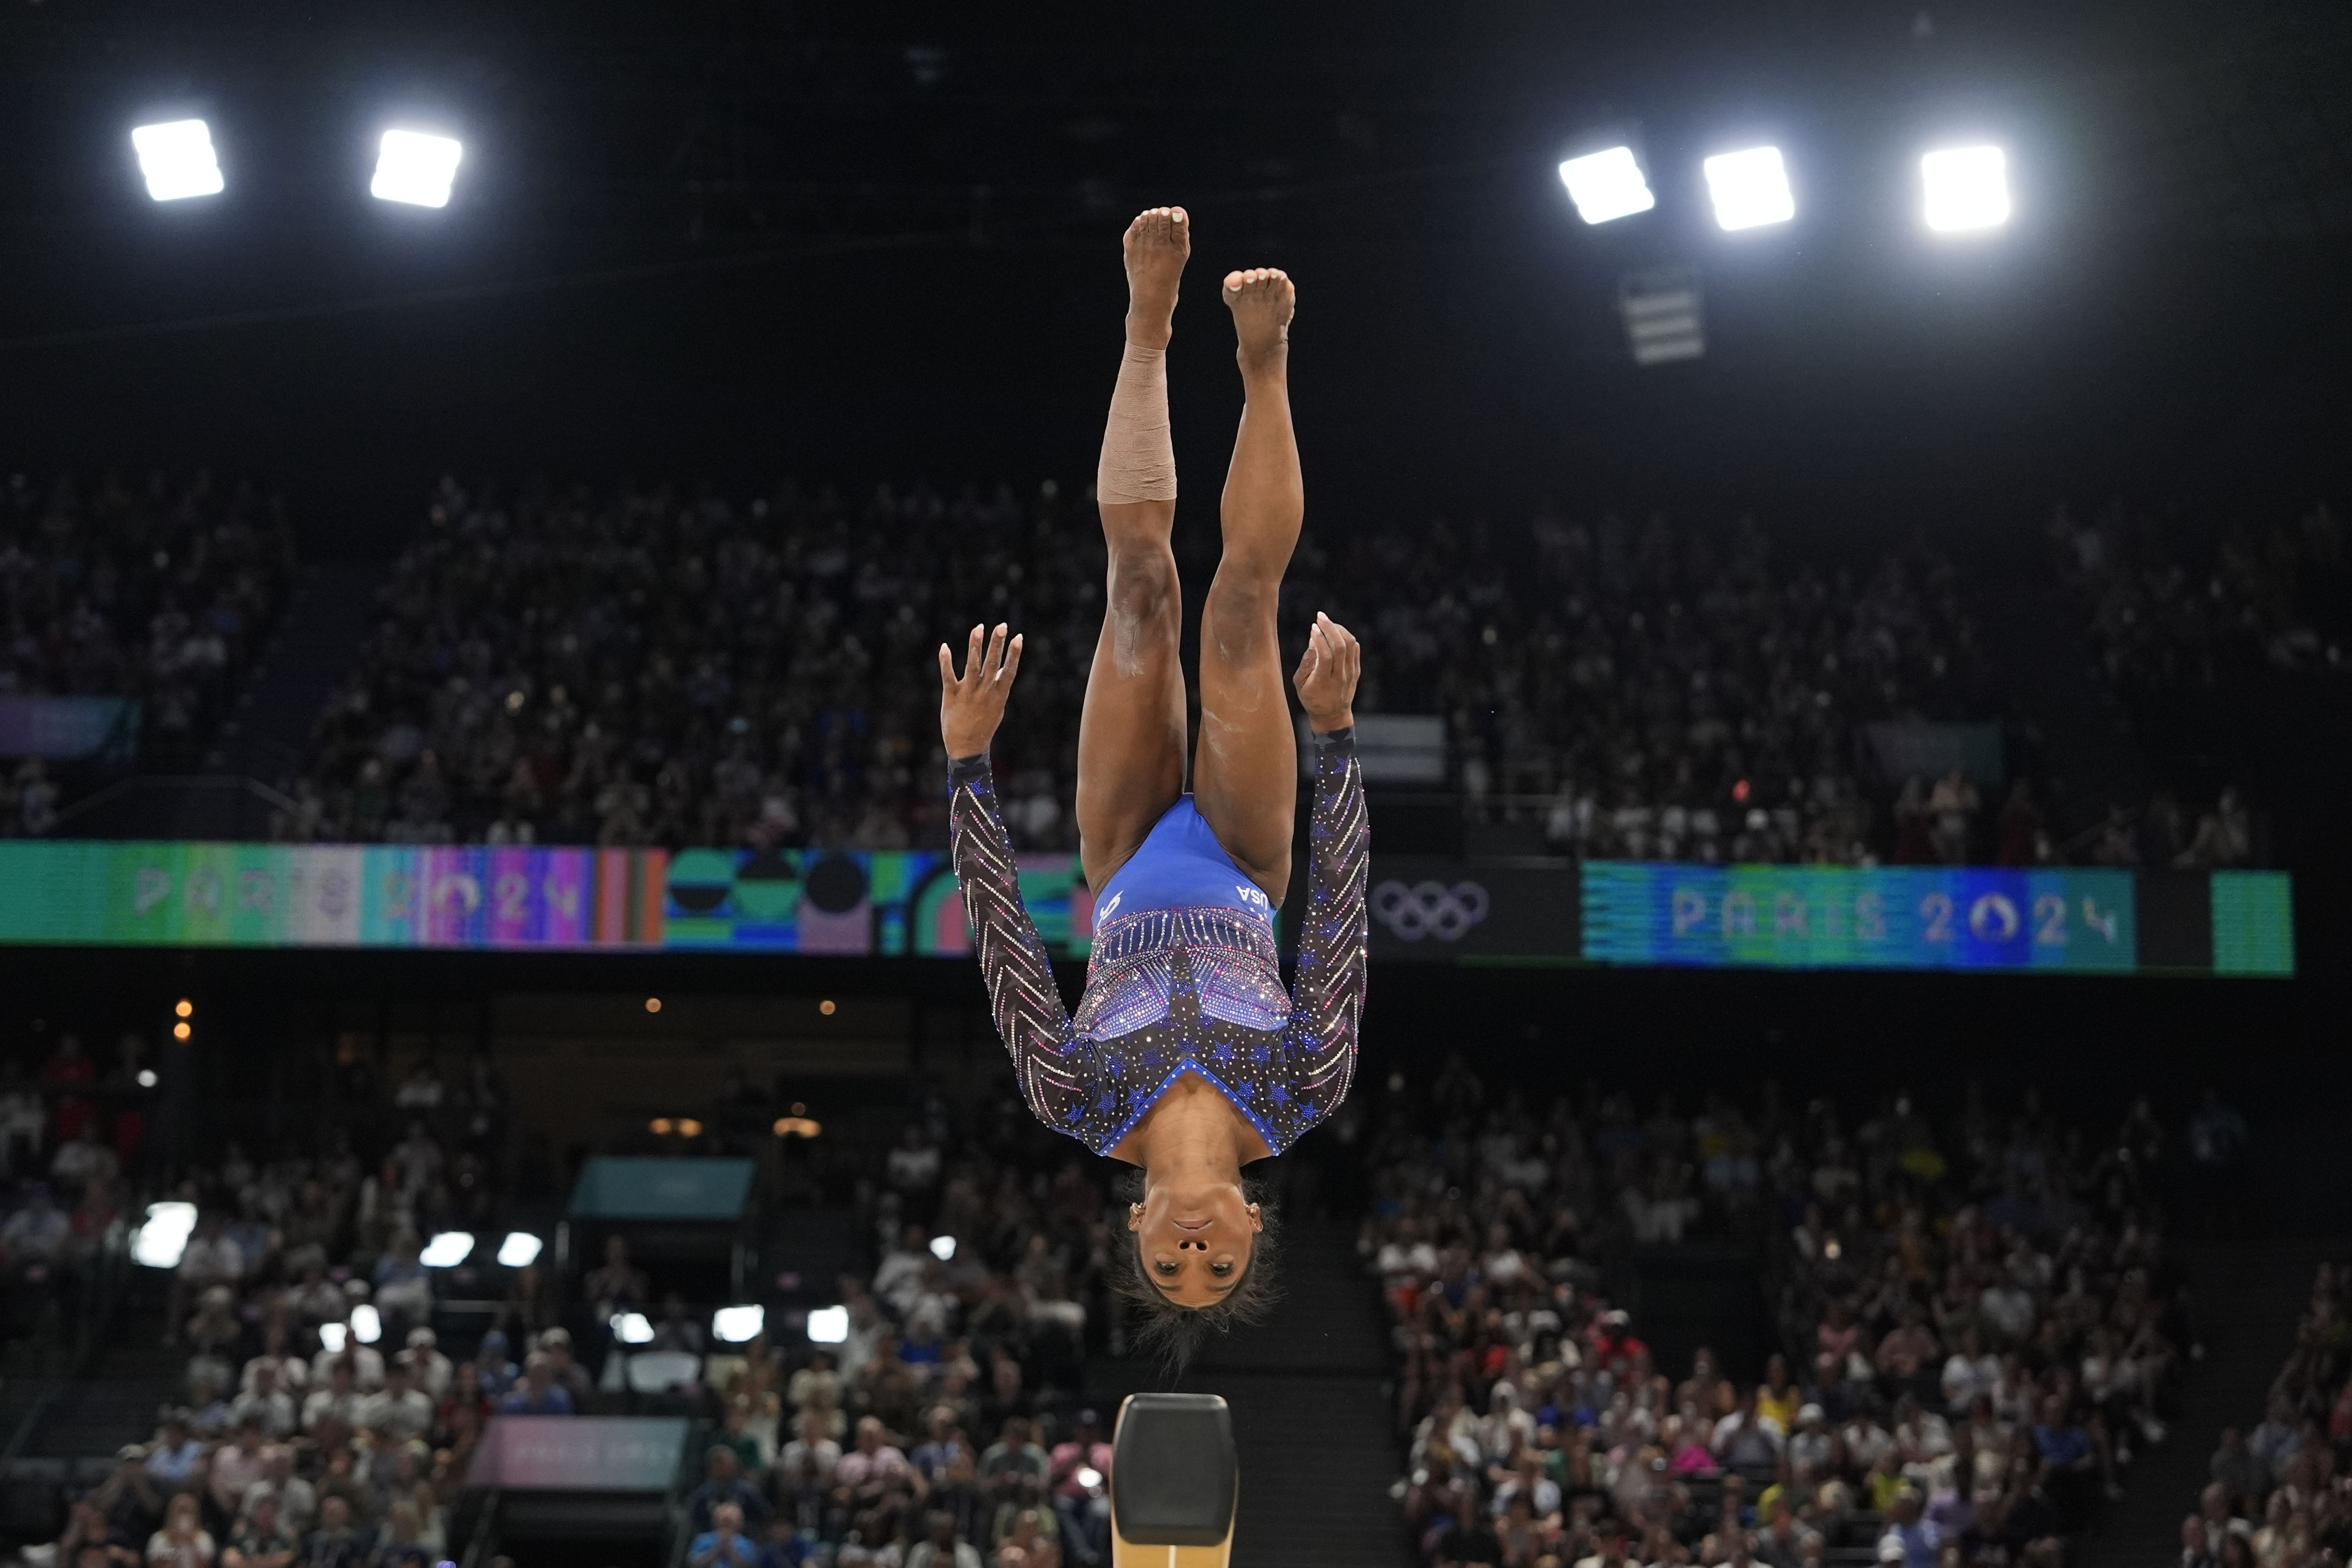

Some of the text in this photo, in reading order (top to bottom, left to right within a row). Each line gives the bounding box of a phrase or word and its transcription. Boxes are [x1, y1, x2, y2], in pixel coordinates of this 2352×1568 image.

[133, 867, 579, 919] PARIS 2024
[1236, 886, 1268, 911] USA
[1673, 889, 2118, 945] PARIS 2024
